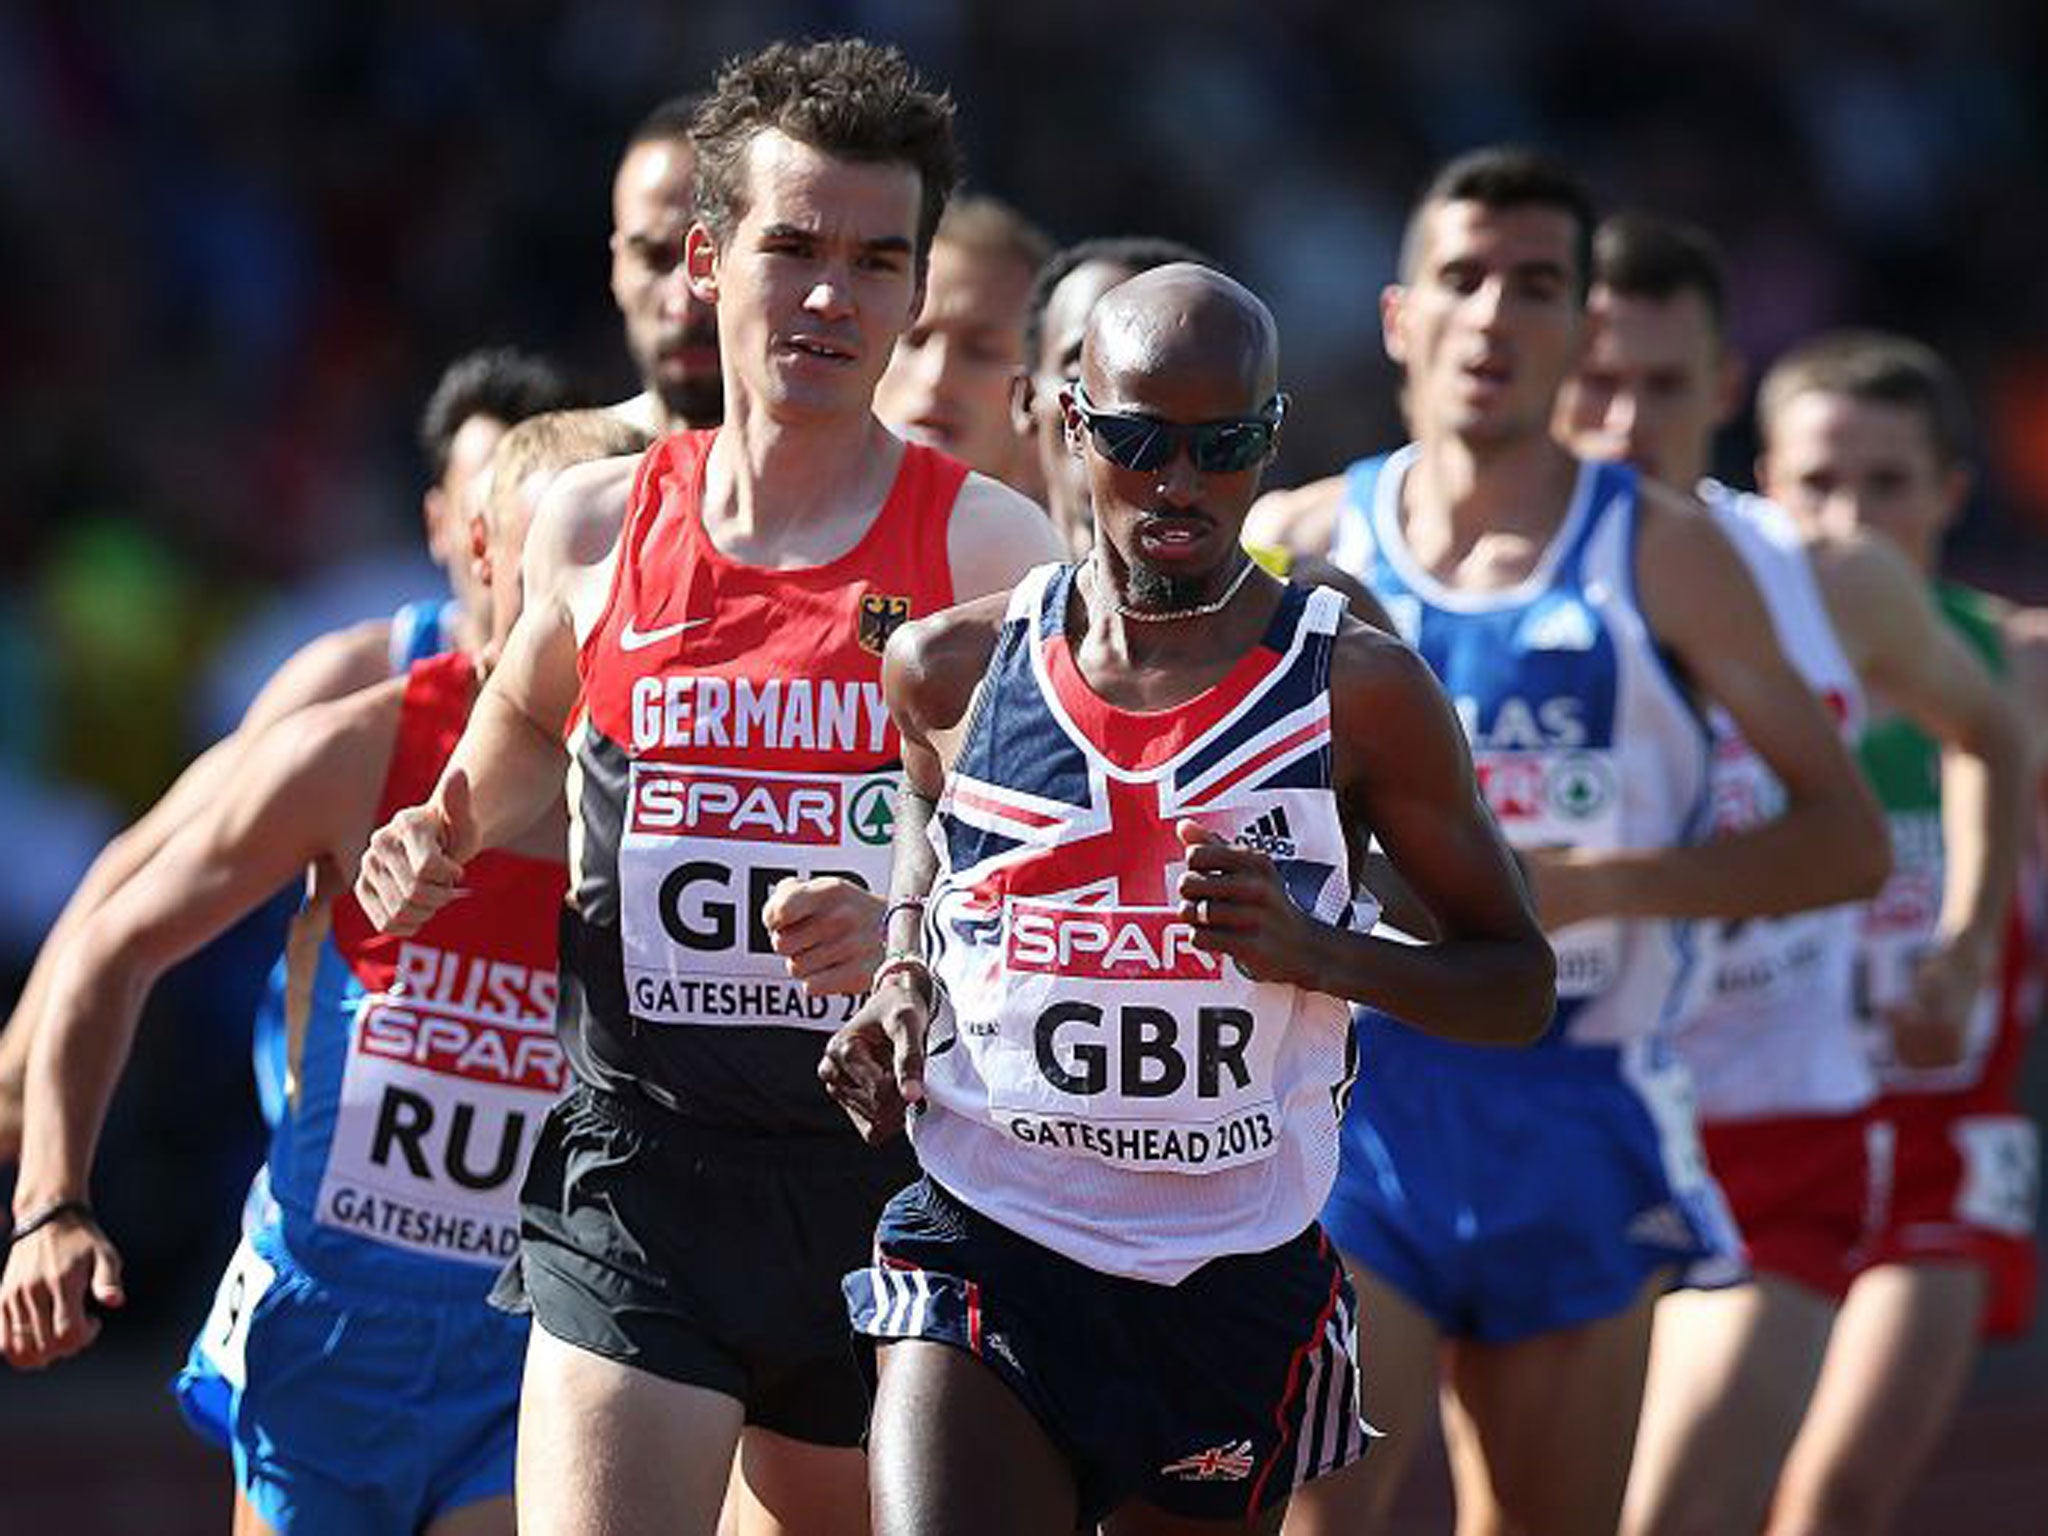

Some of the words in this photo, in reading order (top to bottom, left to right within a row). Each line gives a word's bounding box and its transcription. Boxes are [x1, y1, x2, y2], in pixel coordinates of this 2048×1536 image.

[631, 676, 892, 751] GERMANY
[638, 779, 834, 836] SPAR
[1013, 914, 1217, 970] SPAR
[635, 978, 829, 1020] GATESHEAD
[364, 1006, 561, 1085] SPAR
[1033, 1001, 1255, 1098] GBR
[1011, 1117, 1210, 1163] GATESHEAD
[1216, 1113, 1273, 1159] 2013
[331, 1188, 520, 1258] GATESHEAD
